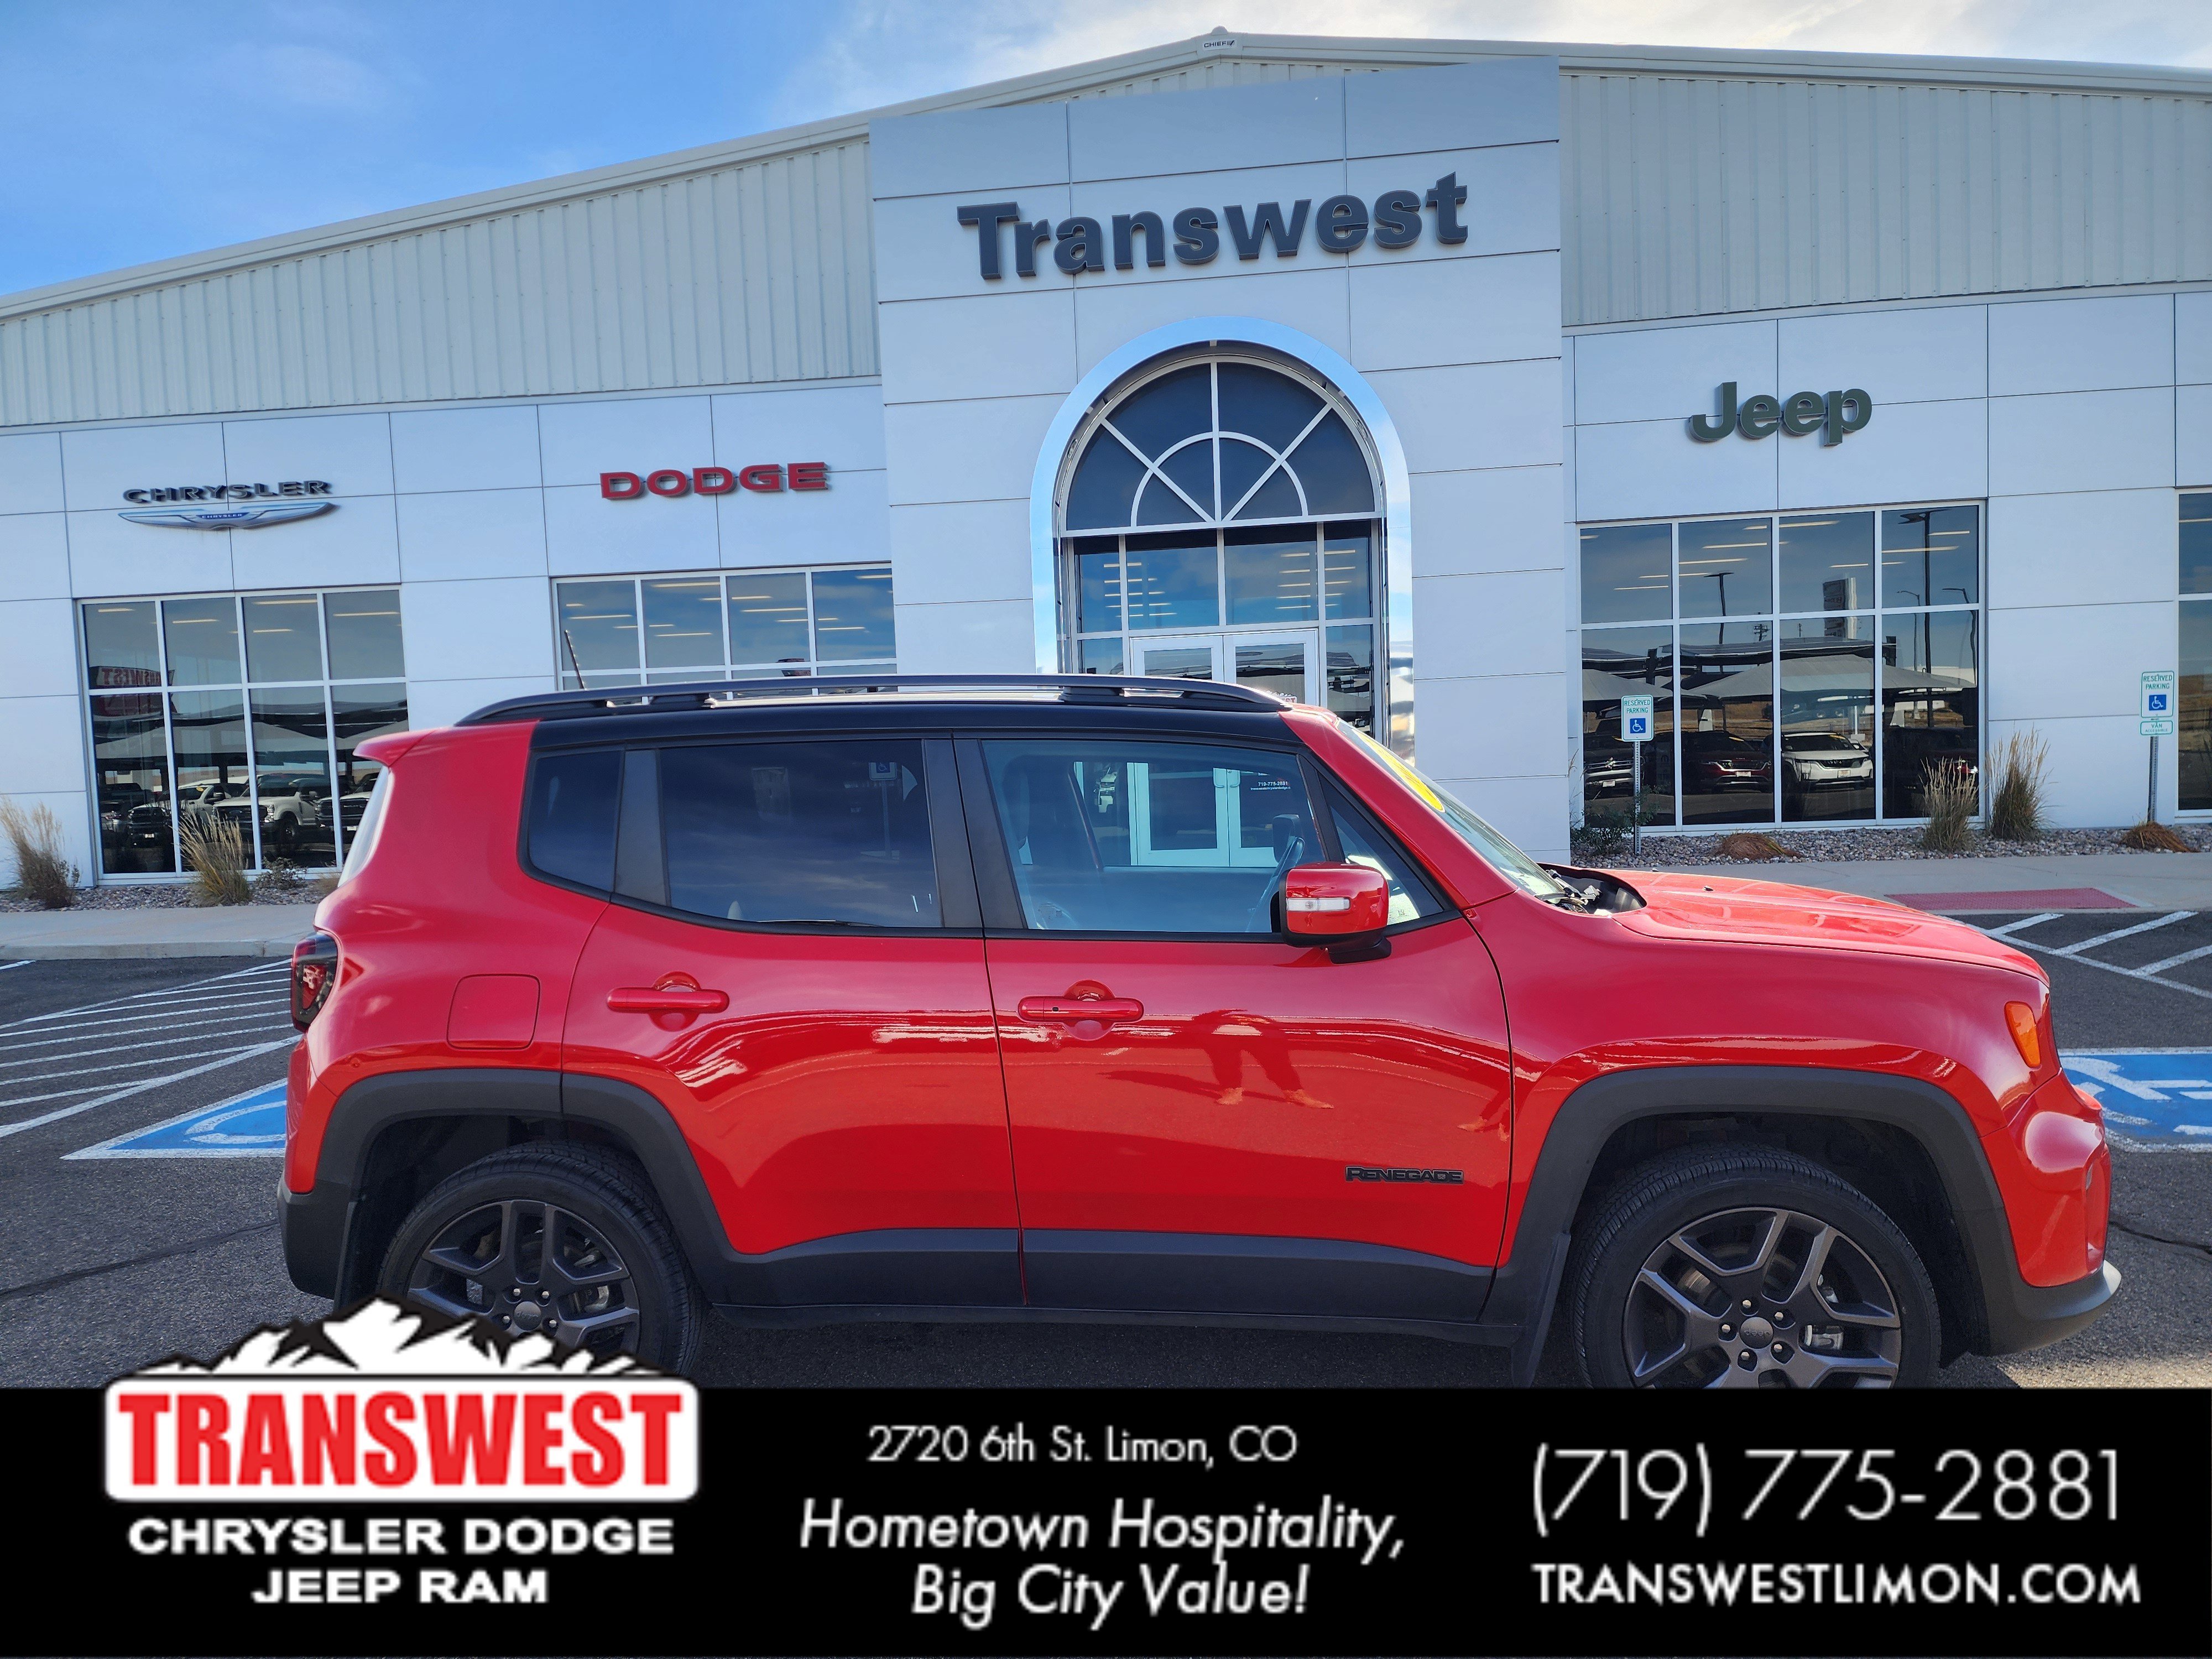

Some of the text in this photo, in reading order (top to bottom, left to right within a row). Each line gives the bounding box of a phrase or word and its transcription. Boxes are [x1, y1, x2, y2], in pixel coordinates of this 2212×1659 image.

[957, 171, 1468, 280] Transwest
[1688, 382, 1872, 447] Jeep
[123, 480, 330, 503] CHRYSLER
[600, 462, 829, 500] DODGE
[1346, 1166, 1464, 1184] RENEGADE
